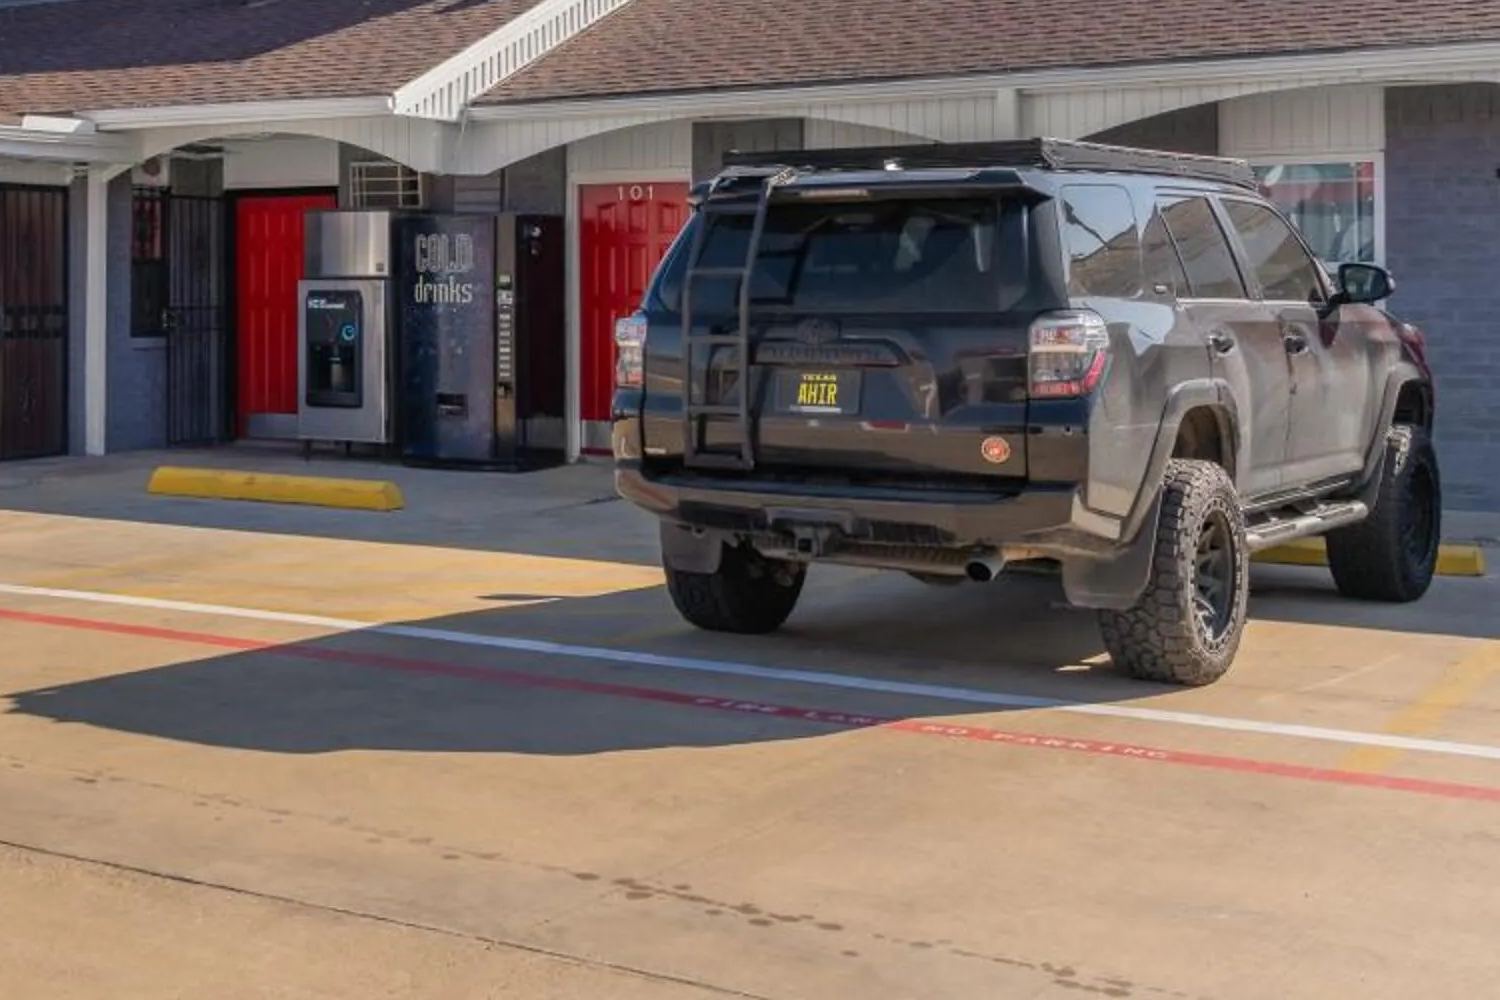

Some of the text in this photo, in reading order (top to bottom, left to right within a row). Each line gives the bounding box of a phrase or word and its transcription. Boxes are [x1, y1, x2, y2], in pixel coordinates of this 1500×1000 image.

[618, 185, 653, 200] 101
[415, 233, 473, 272] COLD
[414, 275, 473, 303] drinks
[797, 383, 837, 405] AHIR
